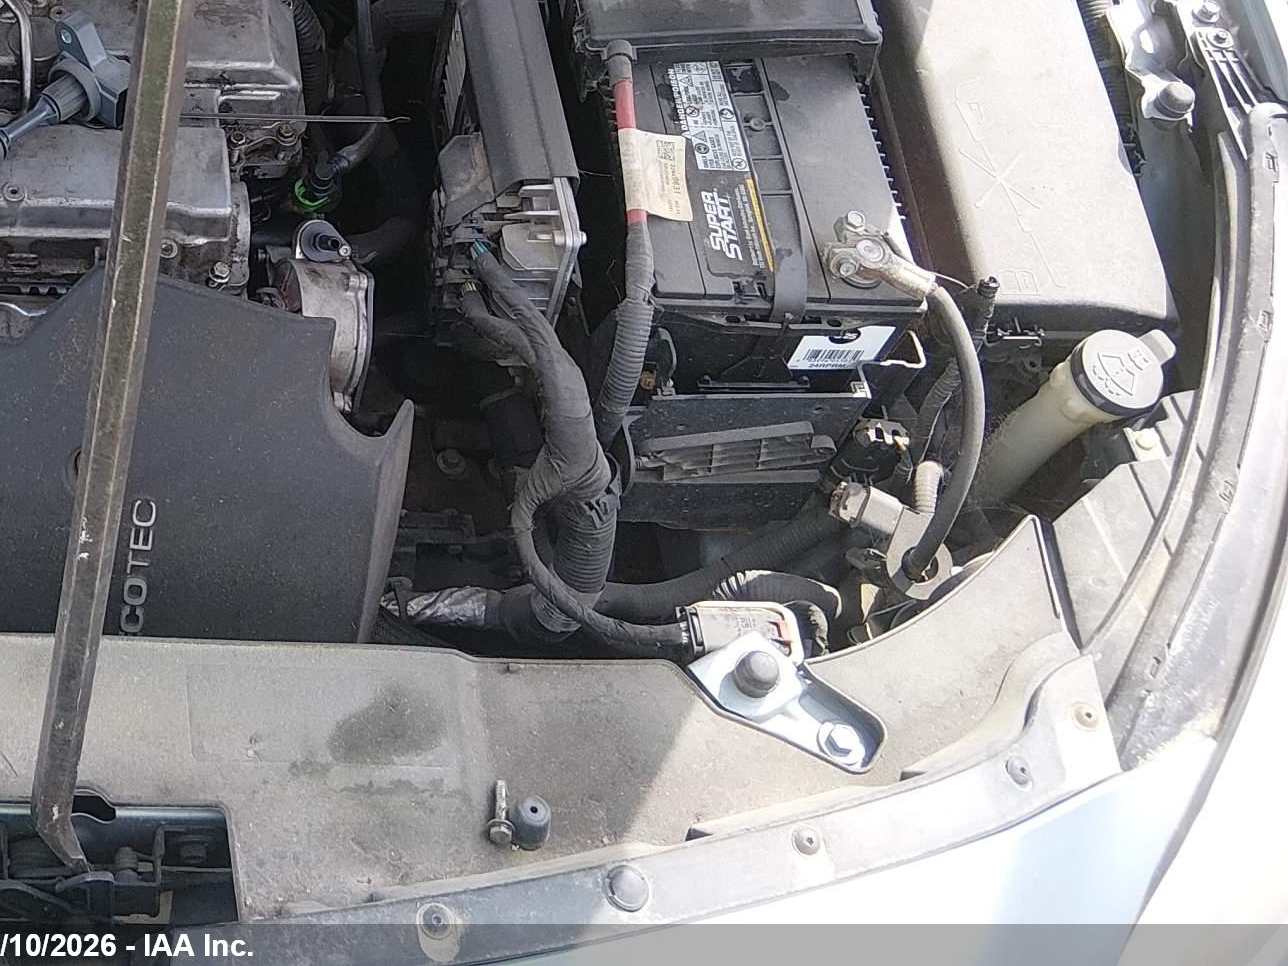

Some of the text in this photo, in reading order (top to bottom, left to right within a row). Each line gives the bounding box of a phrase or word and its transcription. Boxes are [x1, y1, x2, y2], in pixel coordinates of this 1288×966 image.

[668, 69, 689, 131] DANGER/POISON
[700, 190, 726, 252] SUPER
[713, 191, 743, 261] START
[120, 500, 156, 636] COTEC
